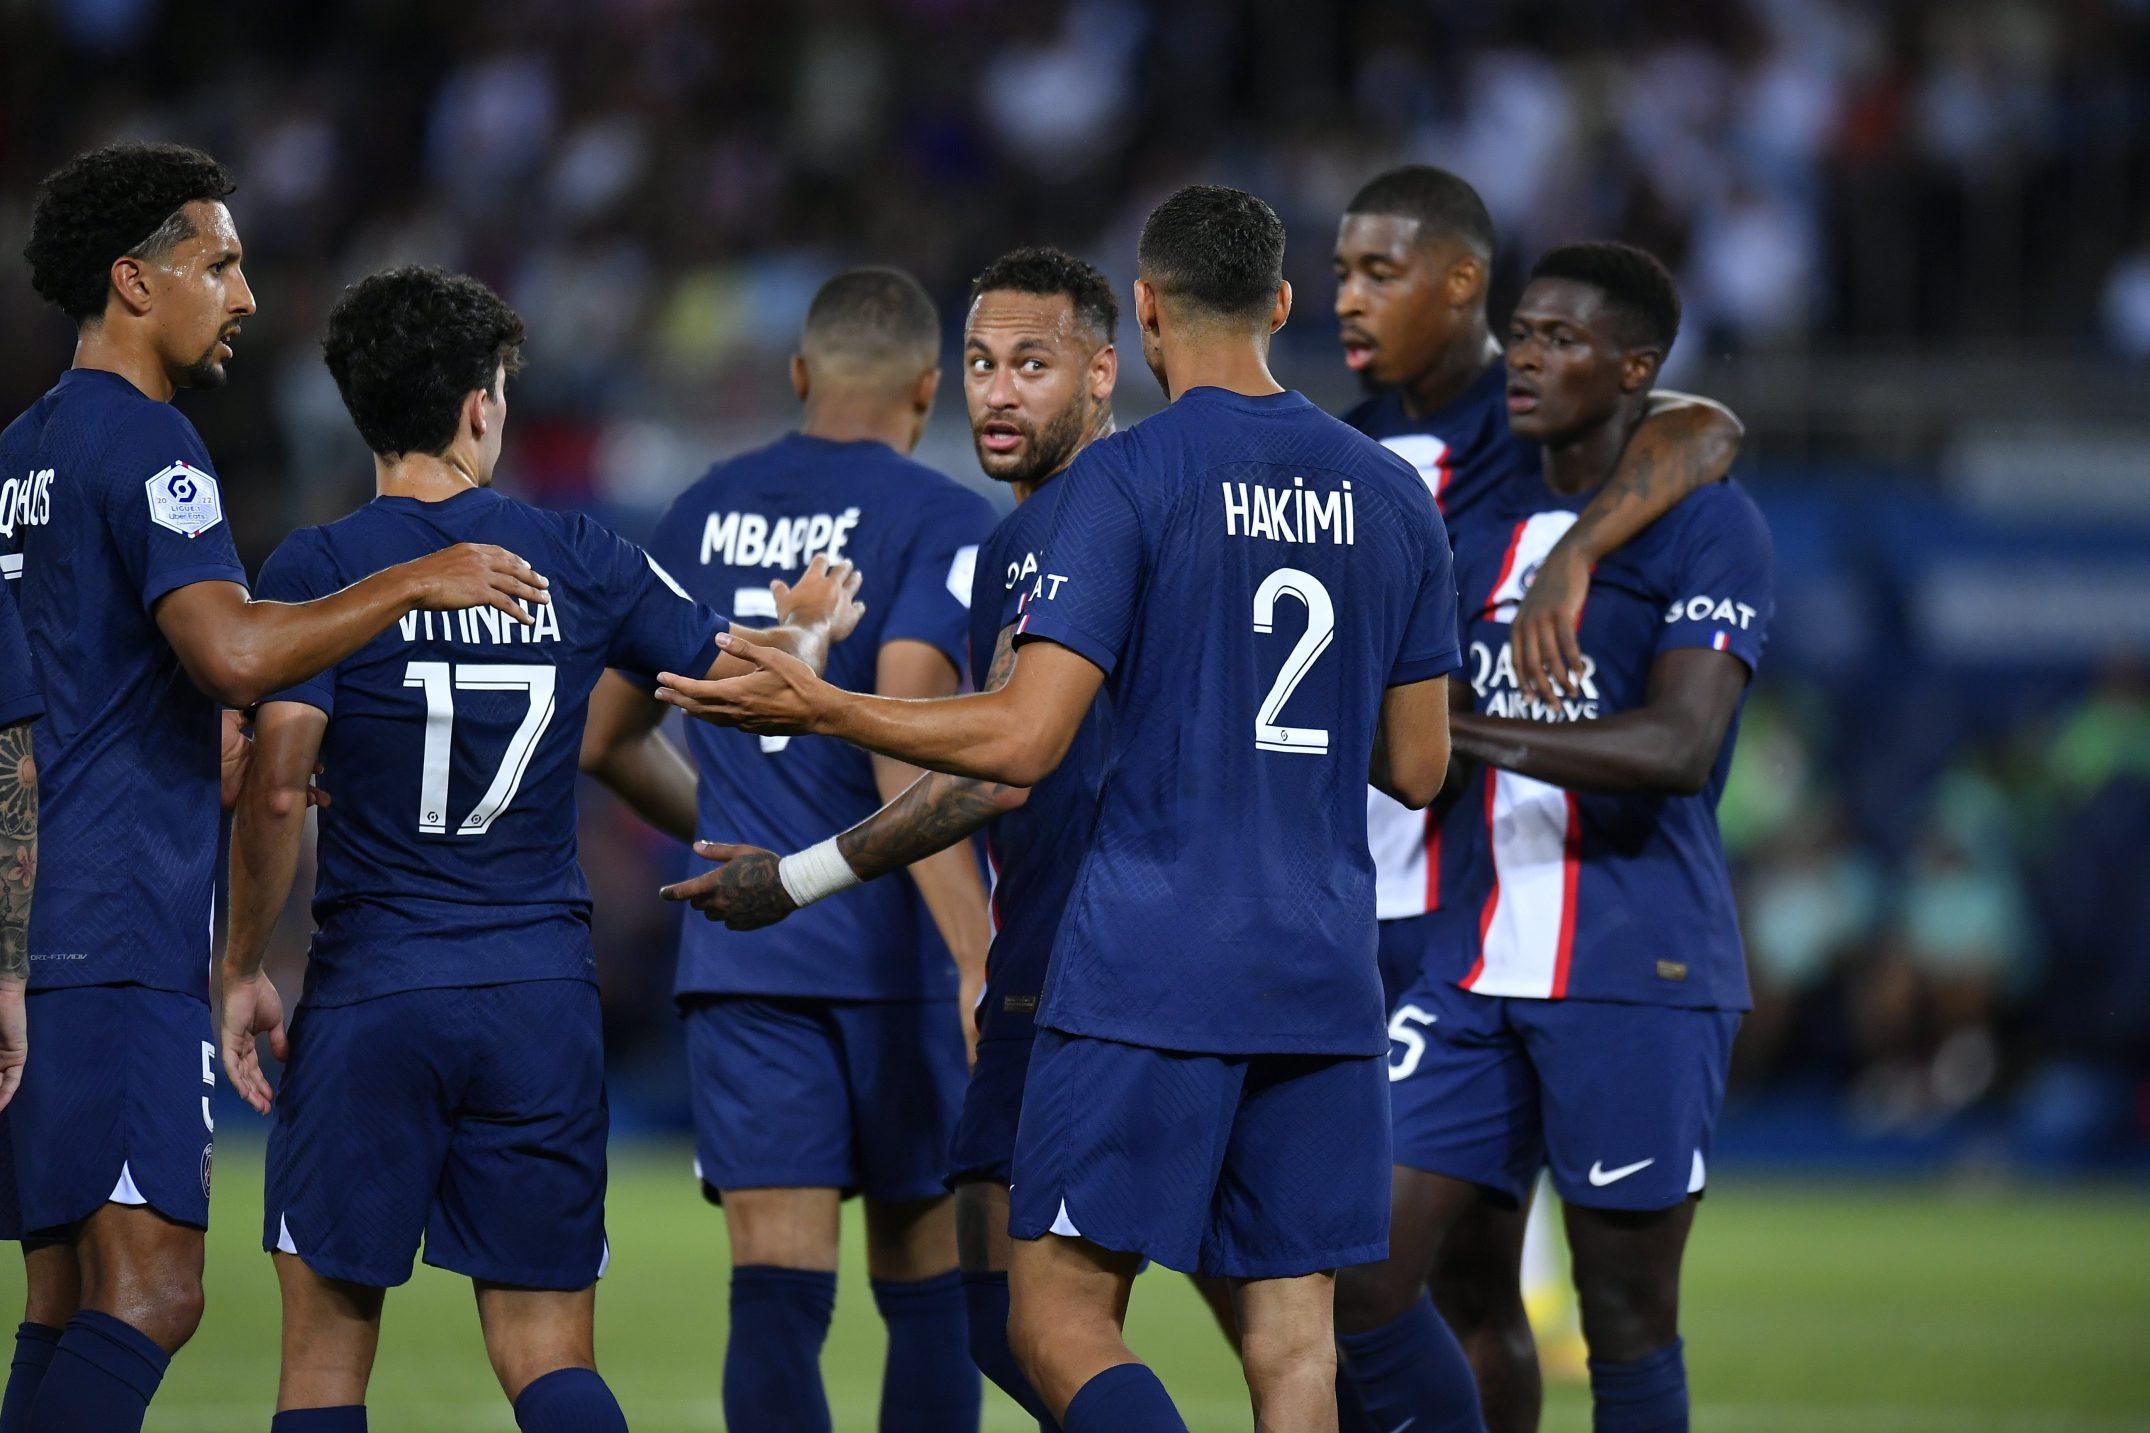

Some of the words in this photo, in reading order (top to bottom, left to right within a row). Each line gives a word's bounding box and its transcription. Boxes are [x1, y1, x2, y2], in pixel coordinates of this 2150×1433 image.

[187, 512, 206, 520] Eats
[700, 506, 861, 570] MBAPPÉ
[1253, 567, 1334, 755] 2
[1469, 640, 1600, 700] QAR
[402, 661, 557, 835] 17
